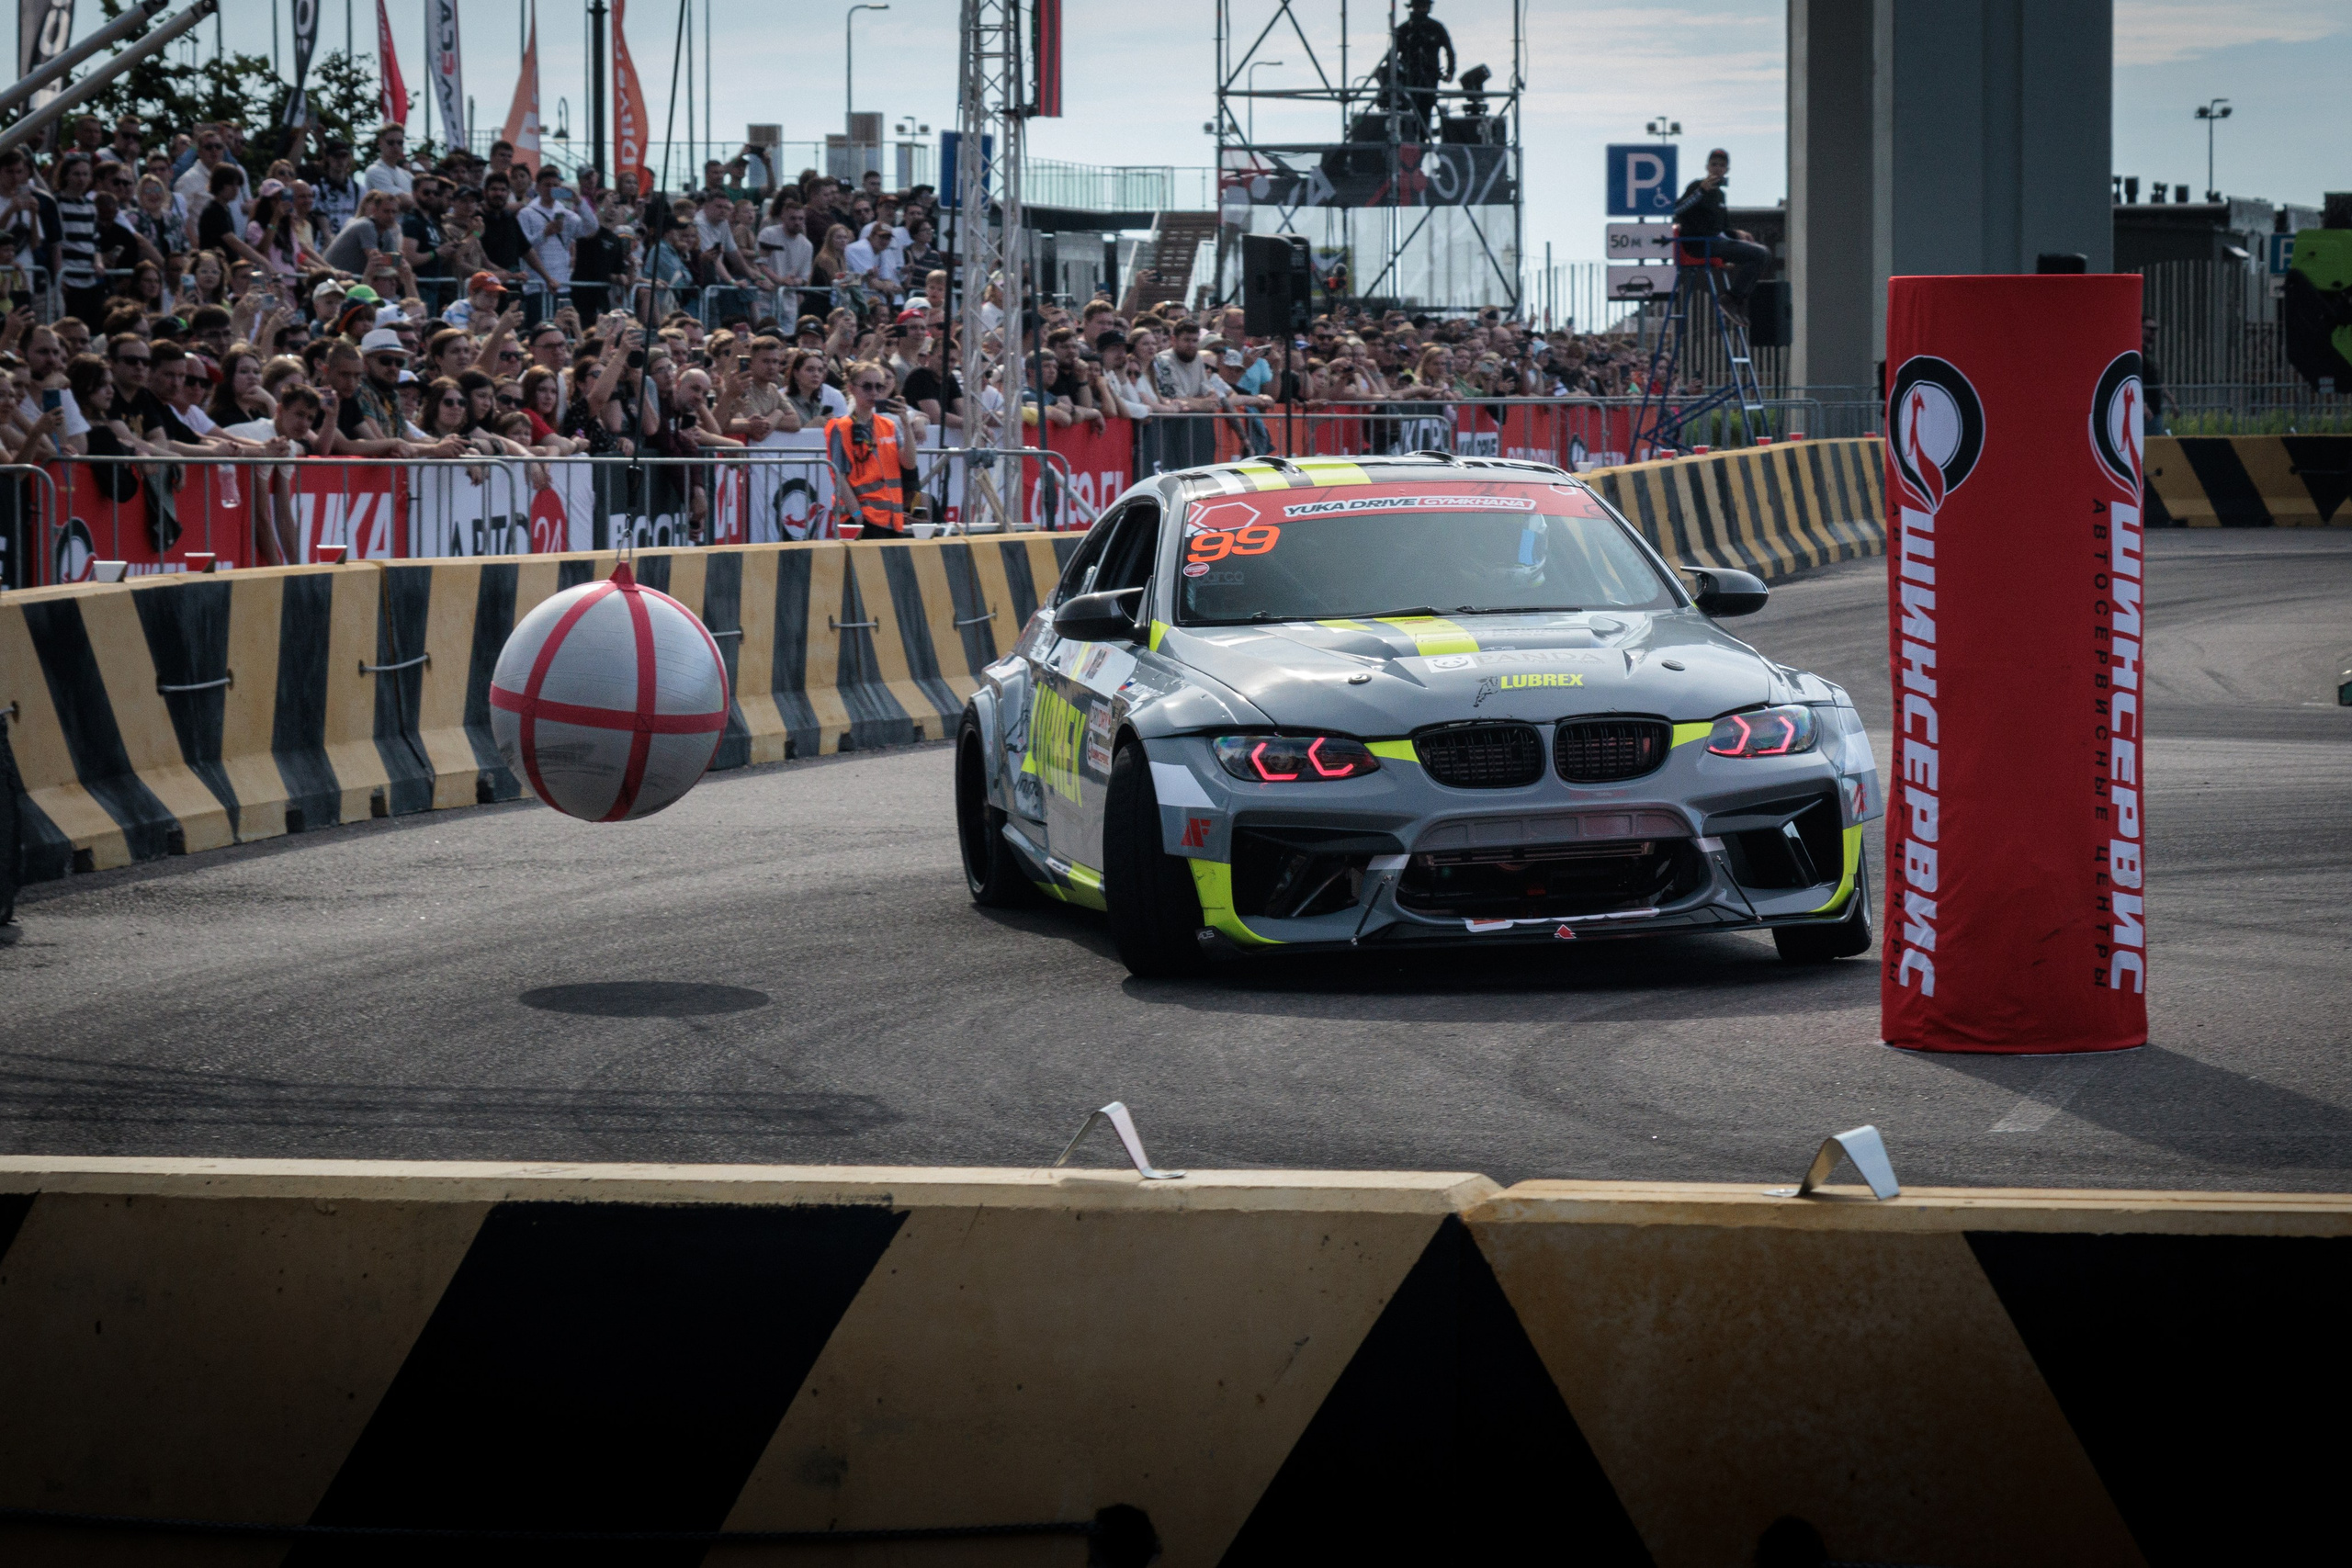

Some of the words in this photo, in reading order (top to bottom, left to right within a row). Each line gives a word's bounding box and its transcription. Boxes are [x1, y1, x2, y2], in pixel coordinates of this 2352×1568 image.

[1626, 152, 1665, 209] P
[1187, 525, 1281, 563] 99
[1287, 502, 1344, 515] YUKA
[1349, 498, 1418, 510] DRIVE
[1424, 497, 1526, 507] GYMKHANA
[1500, 673, 1584, 689] LUBREX
[2093, 498, 2109, 820] АВТОСЕРВИСНЫЕ
[1899, 505, 1940, 998] ШИНСЕРВИС
[2110, 501, 2143, 994] ШИНСЕРВИС
[2094, 845, 2110, 987] ЦЕНТРЫ
